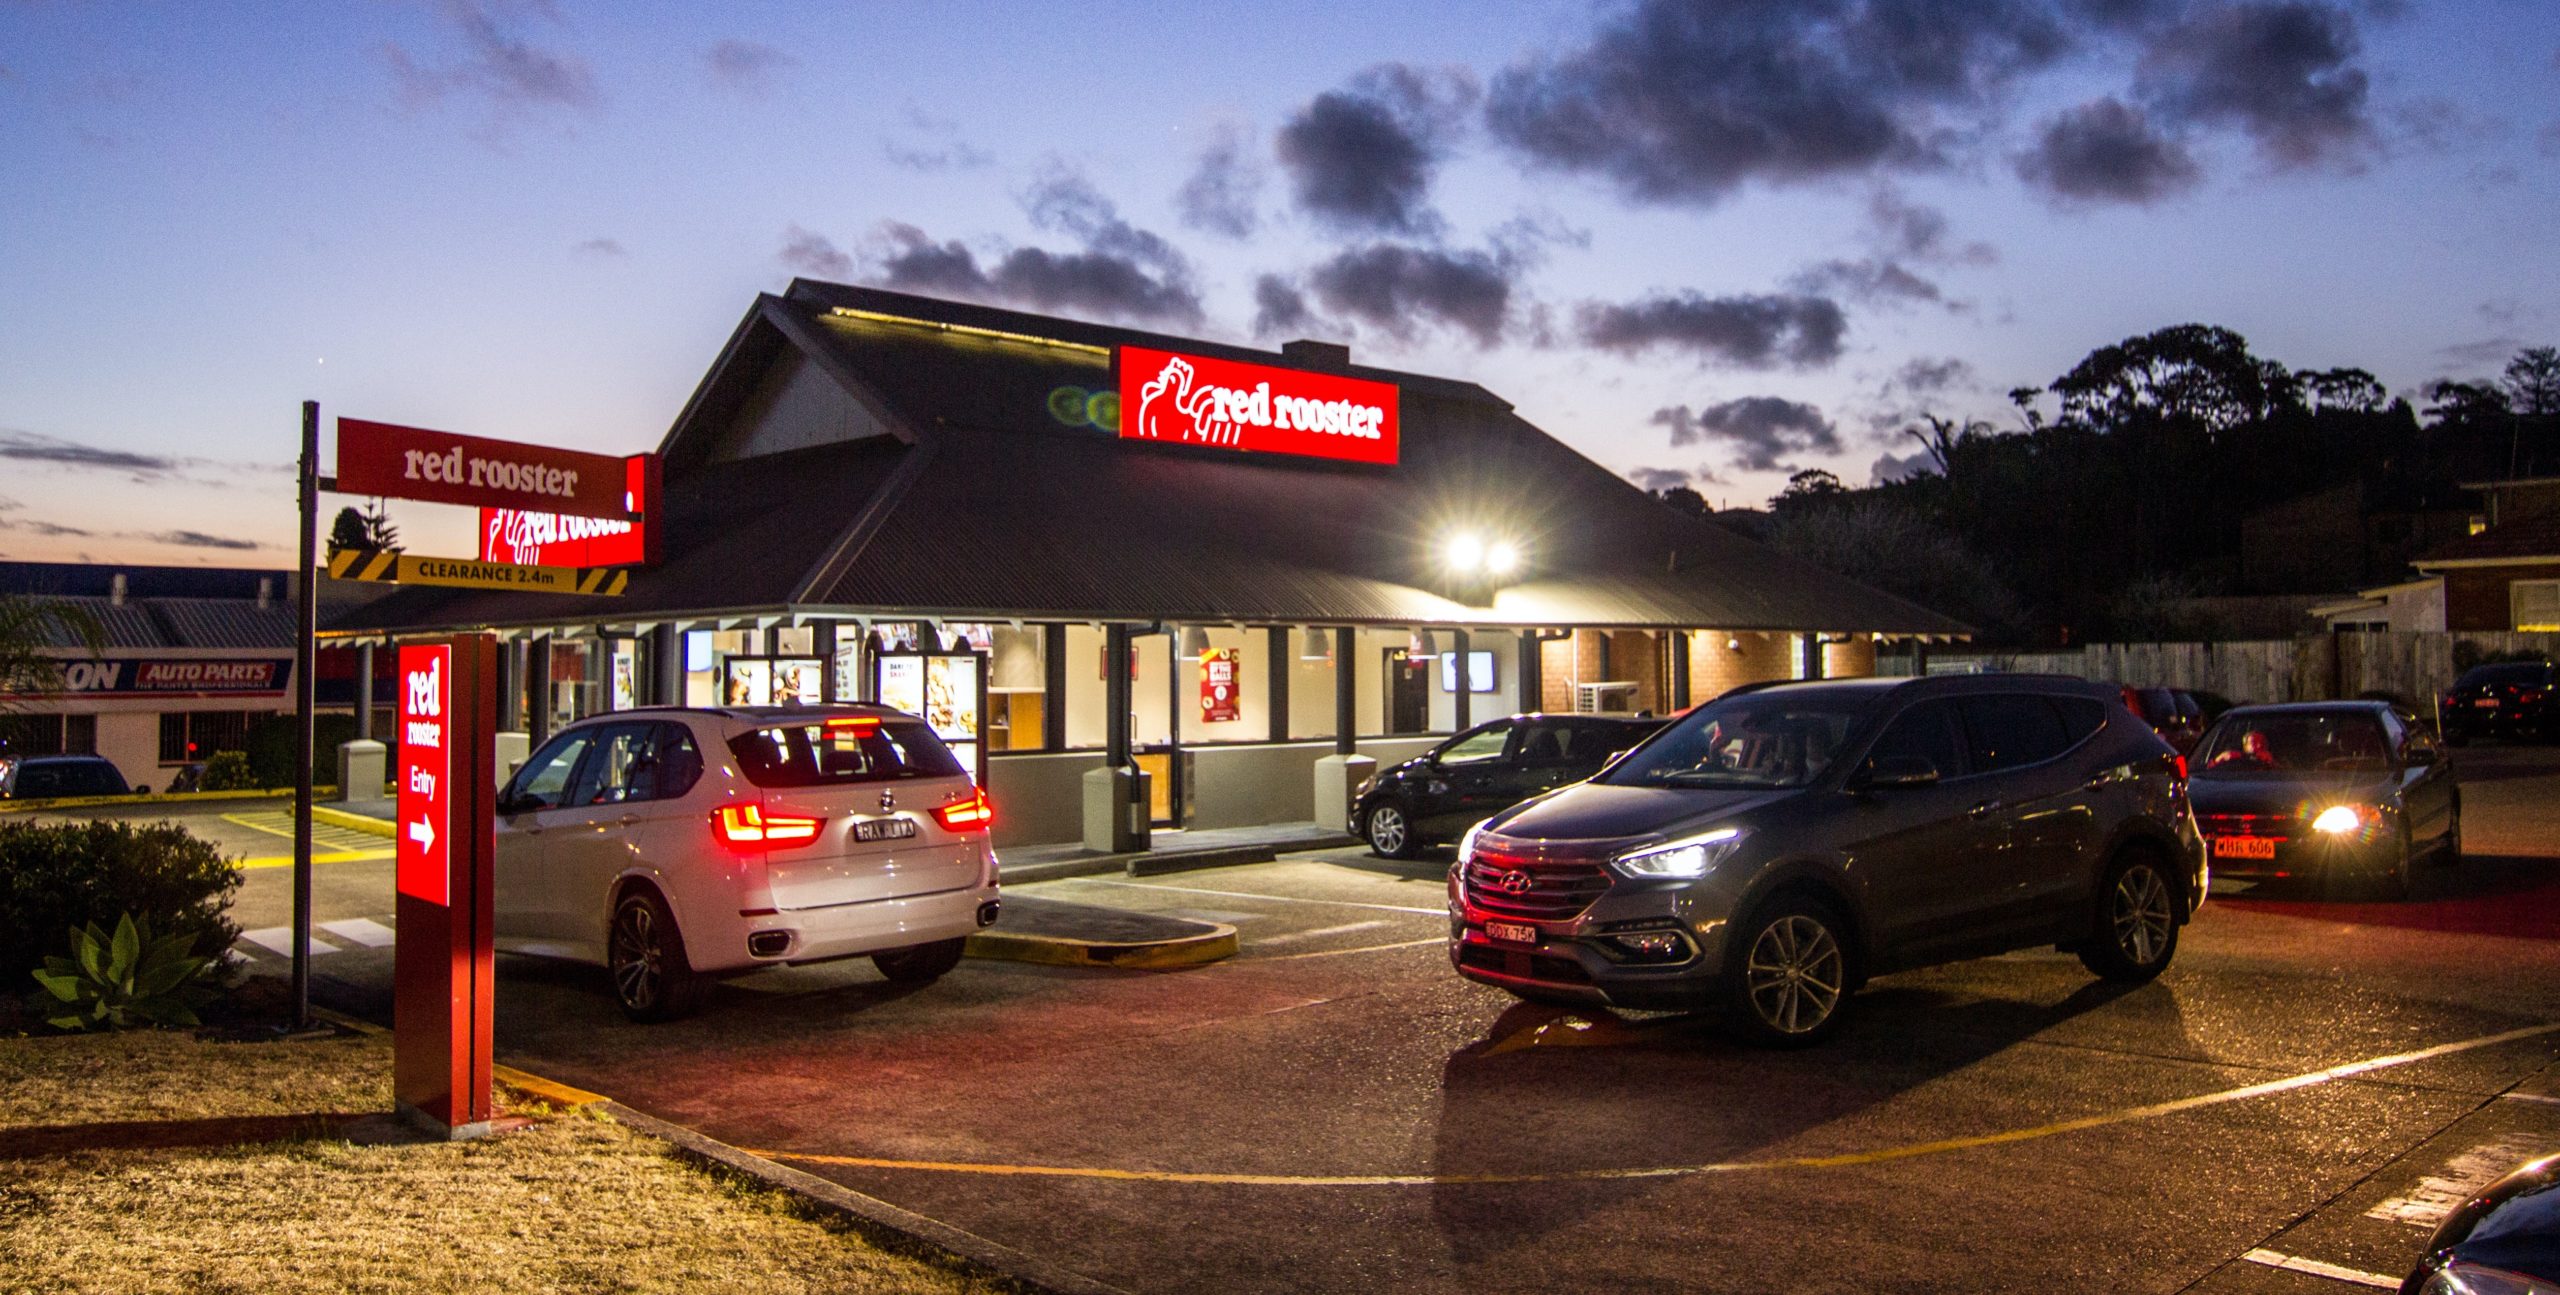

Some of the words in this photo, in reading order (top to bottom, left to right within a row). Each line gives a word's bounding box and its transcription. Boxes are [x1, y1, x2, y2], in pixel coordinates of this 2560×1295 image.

[1211, 382, 1272, 426] red
[1273, 394, 1383, 439] rooster
[404, 445, 464, 485] red
[469, 453, 577, 497] rooster
[419, 562, 513, 582] CLEARANCE
[518, 570, 554, 584] 2.4m
[147, 664, 202, 680] AUTO
[204, 664, 266, 680] PARTS
[407, 656, 441, 716] red
[407, 721, 441, 748] rooster
[410, 765, 436, 802] Entry
